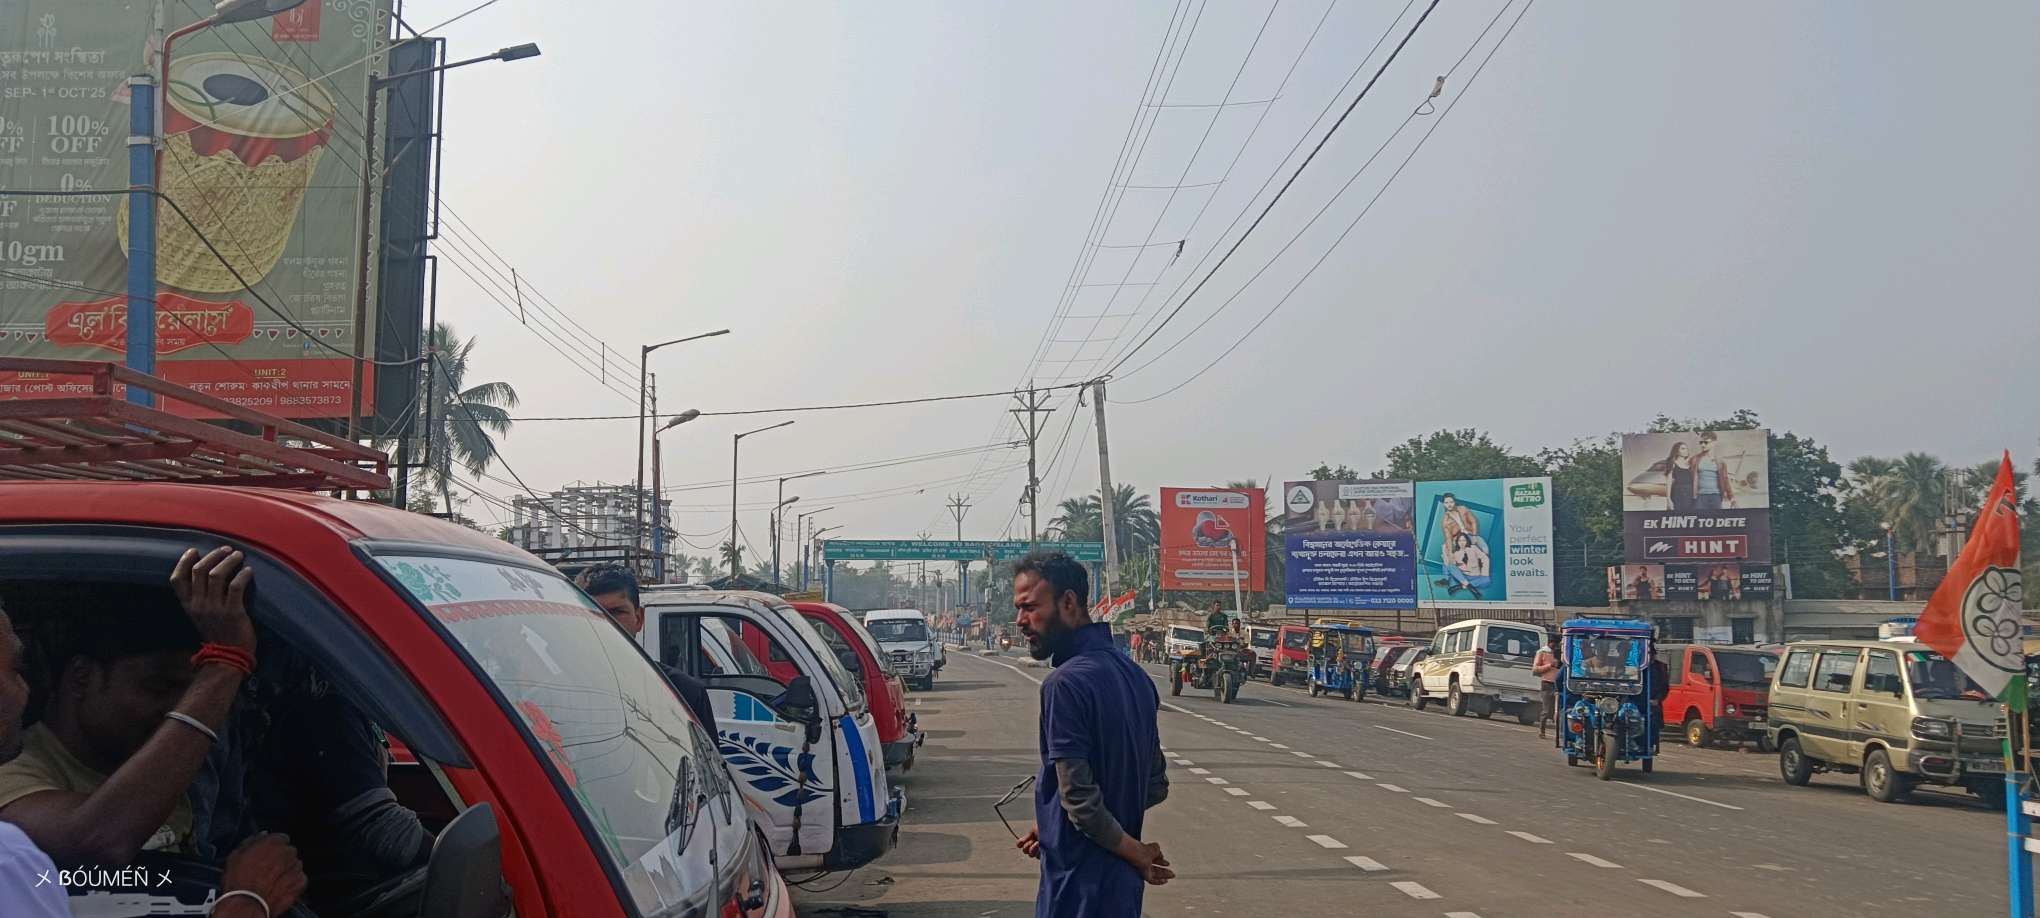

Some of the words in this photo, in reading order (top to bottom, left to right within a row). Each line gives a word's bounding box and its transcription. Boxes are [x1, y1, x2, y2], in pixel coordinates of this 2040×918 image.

[58, 87, 106, 98] OCT'25
[48, 115, 109, 136] 100%
[51, 136, 102, 153] OFF
[60, 173, 93, 192] 0%
[36, 194, 112, 204] DEDUCTION
[255, 368, 287, 378] UNIT:2
[1643, 519, 1658, 529] EK
[1660, 515, 1698, 529] HINT
[1698, 519, 1714, 528] TO
[1715, 517, 1747, 528] DETE
[911, 541, 949, 549] WELCOME
[953, 541, 962, 549] TO
[1511, 545, 1546, 554] winter
[1685, 540, 1739, 553] HINT
[1510, 557, 1535, 566] look
